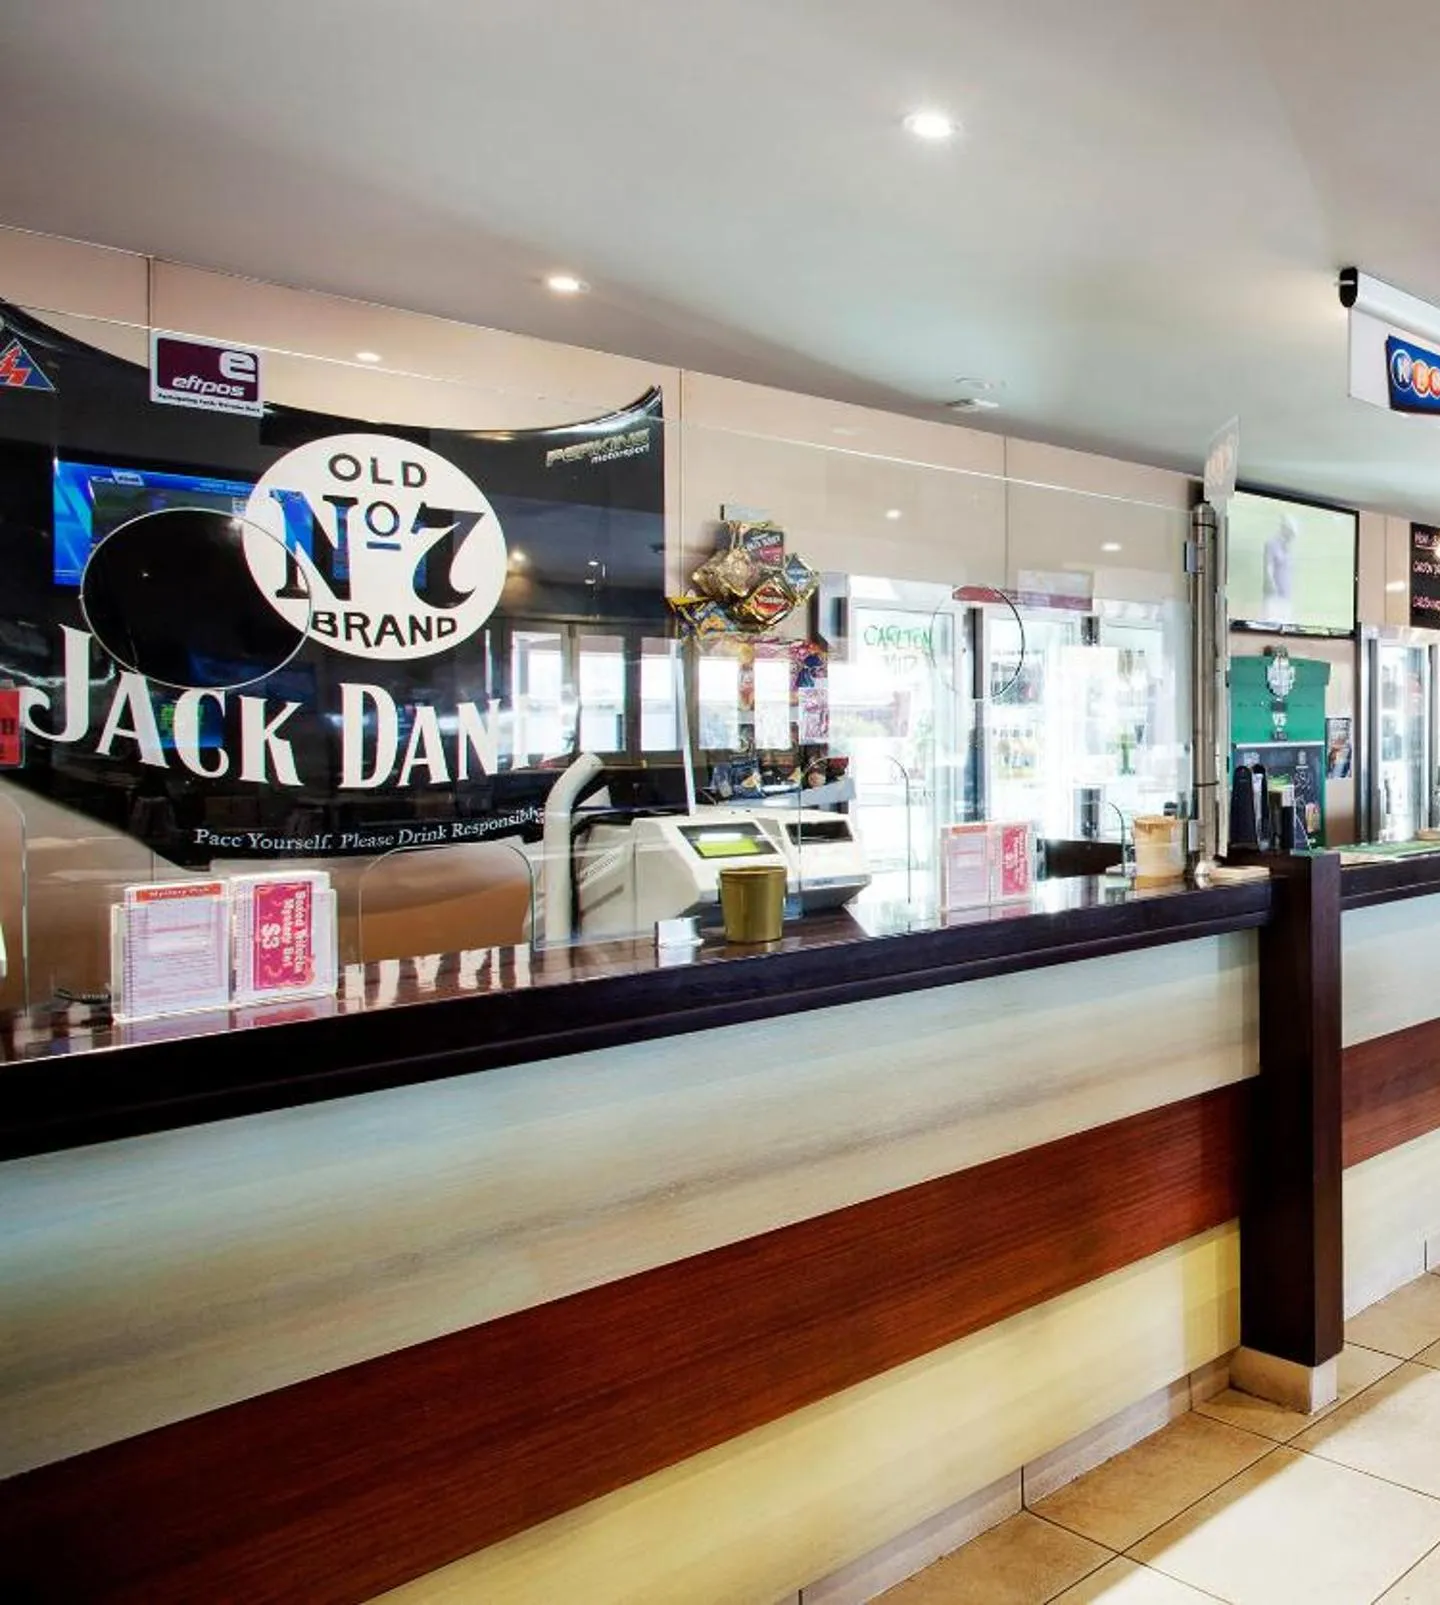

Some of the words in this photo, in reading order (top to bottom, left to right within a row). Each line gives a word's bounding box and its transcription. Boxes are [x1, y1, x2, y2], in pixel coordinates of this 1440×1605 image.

[172, 376, 245, 397] eftpos
[329, 452, 426, 489] OLD
[311, 610, 458, 649] BRAND
[21, 623, 303, 787] JACK
[193, 828, 242, 848] Pace
[245, 832, 332, 850] Yourself.
[340, 833, 394, 849] Please
[398, 824, 447, 845] Drink
[261, 922, 281, 949] $3
